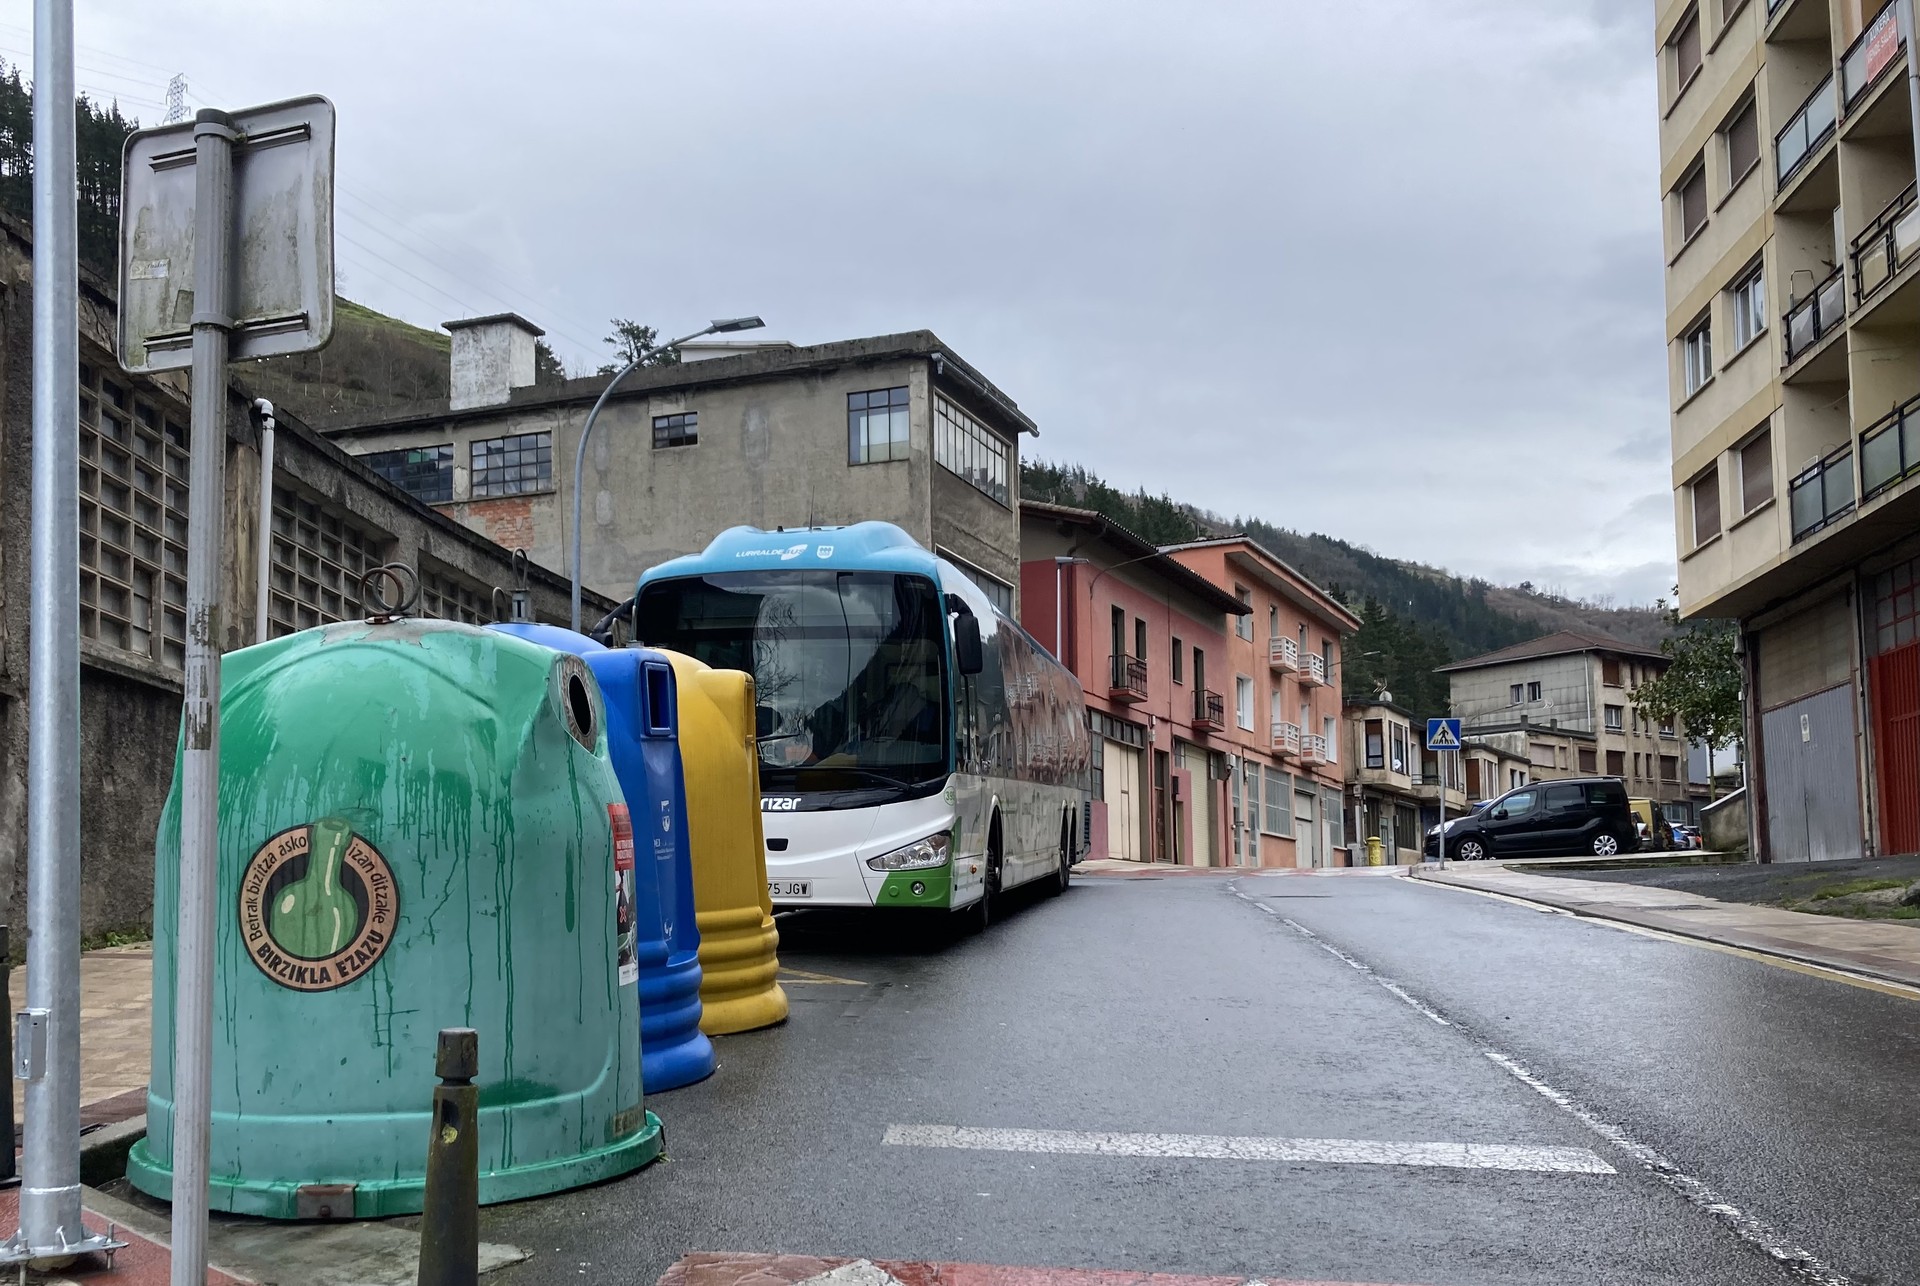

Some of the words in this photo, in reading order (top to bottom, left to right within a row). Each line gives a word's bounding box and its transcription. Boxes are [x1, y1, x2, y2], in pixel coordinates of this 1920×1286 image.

[760, 797, 802, 810] rizar
[278, 836, 307, 857] asko
[348, 843, 375, 874] izan
[246, 853, 277, 895] bizitza
[768, 883, 780, 895] 75
[785, 883, 808, 895] JGW
[370, 872, 391, 924] ditzake
[246, 896, 263, 942] Beirak
[257, 942, 332, 984] BIRZIKLA
[336, 929, 384, 977] EZAZU
